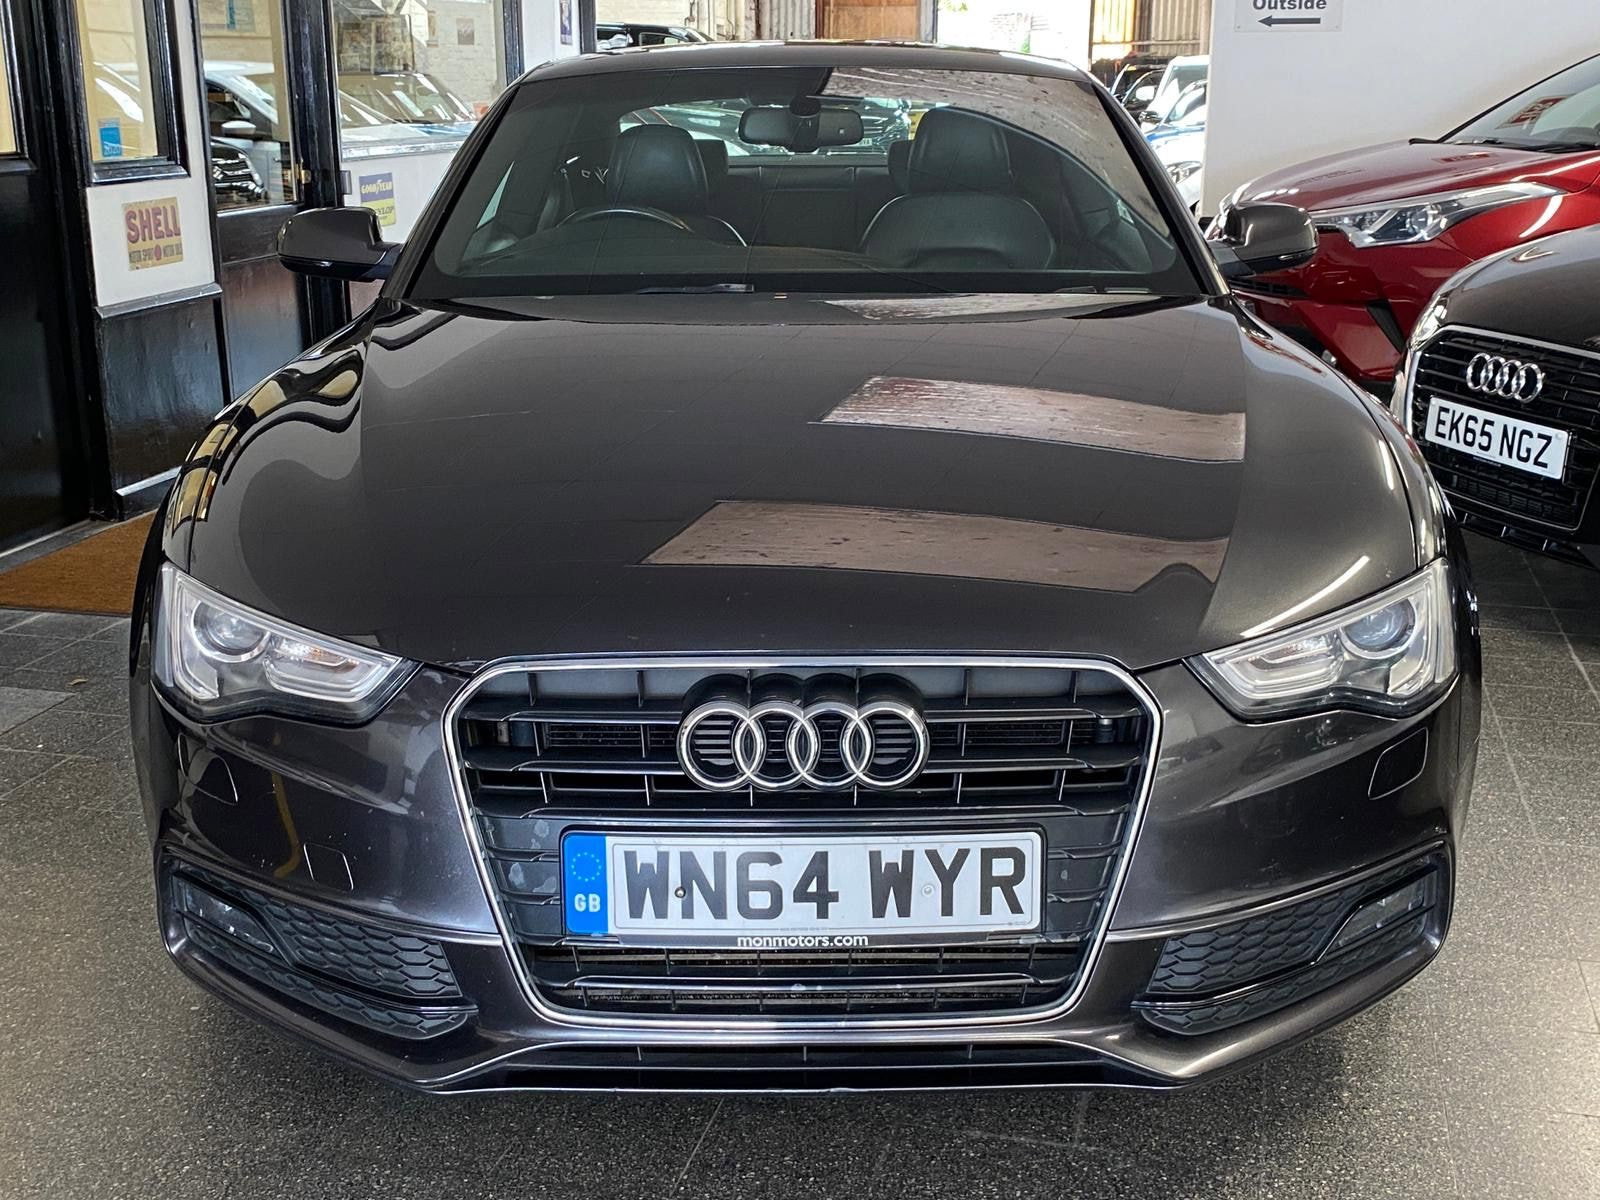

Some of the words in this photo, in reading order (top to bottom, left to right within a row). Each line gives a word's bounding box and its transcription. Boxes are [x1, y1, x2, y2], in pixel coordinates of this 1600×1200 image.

[1252, 0, 1328, 10] Outside
[125, 205, 182, 244] SHELL
[1435, 405, 1495, 452] EK65
[1498, 423, 1553, 469] NGZ
[623, 850, 840, 920] WN64
[868, 846, 1027, 918] WYR
[574, 893, 601, 913] GB
[736, 934, 870, 948] monmotors.com
